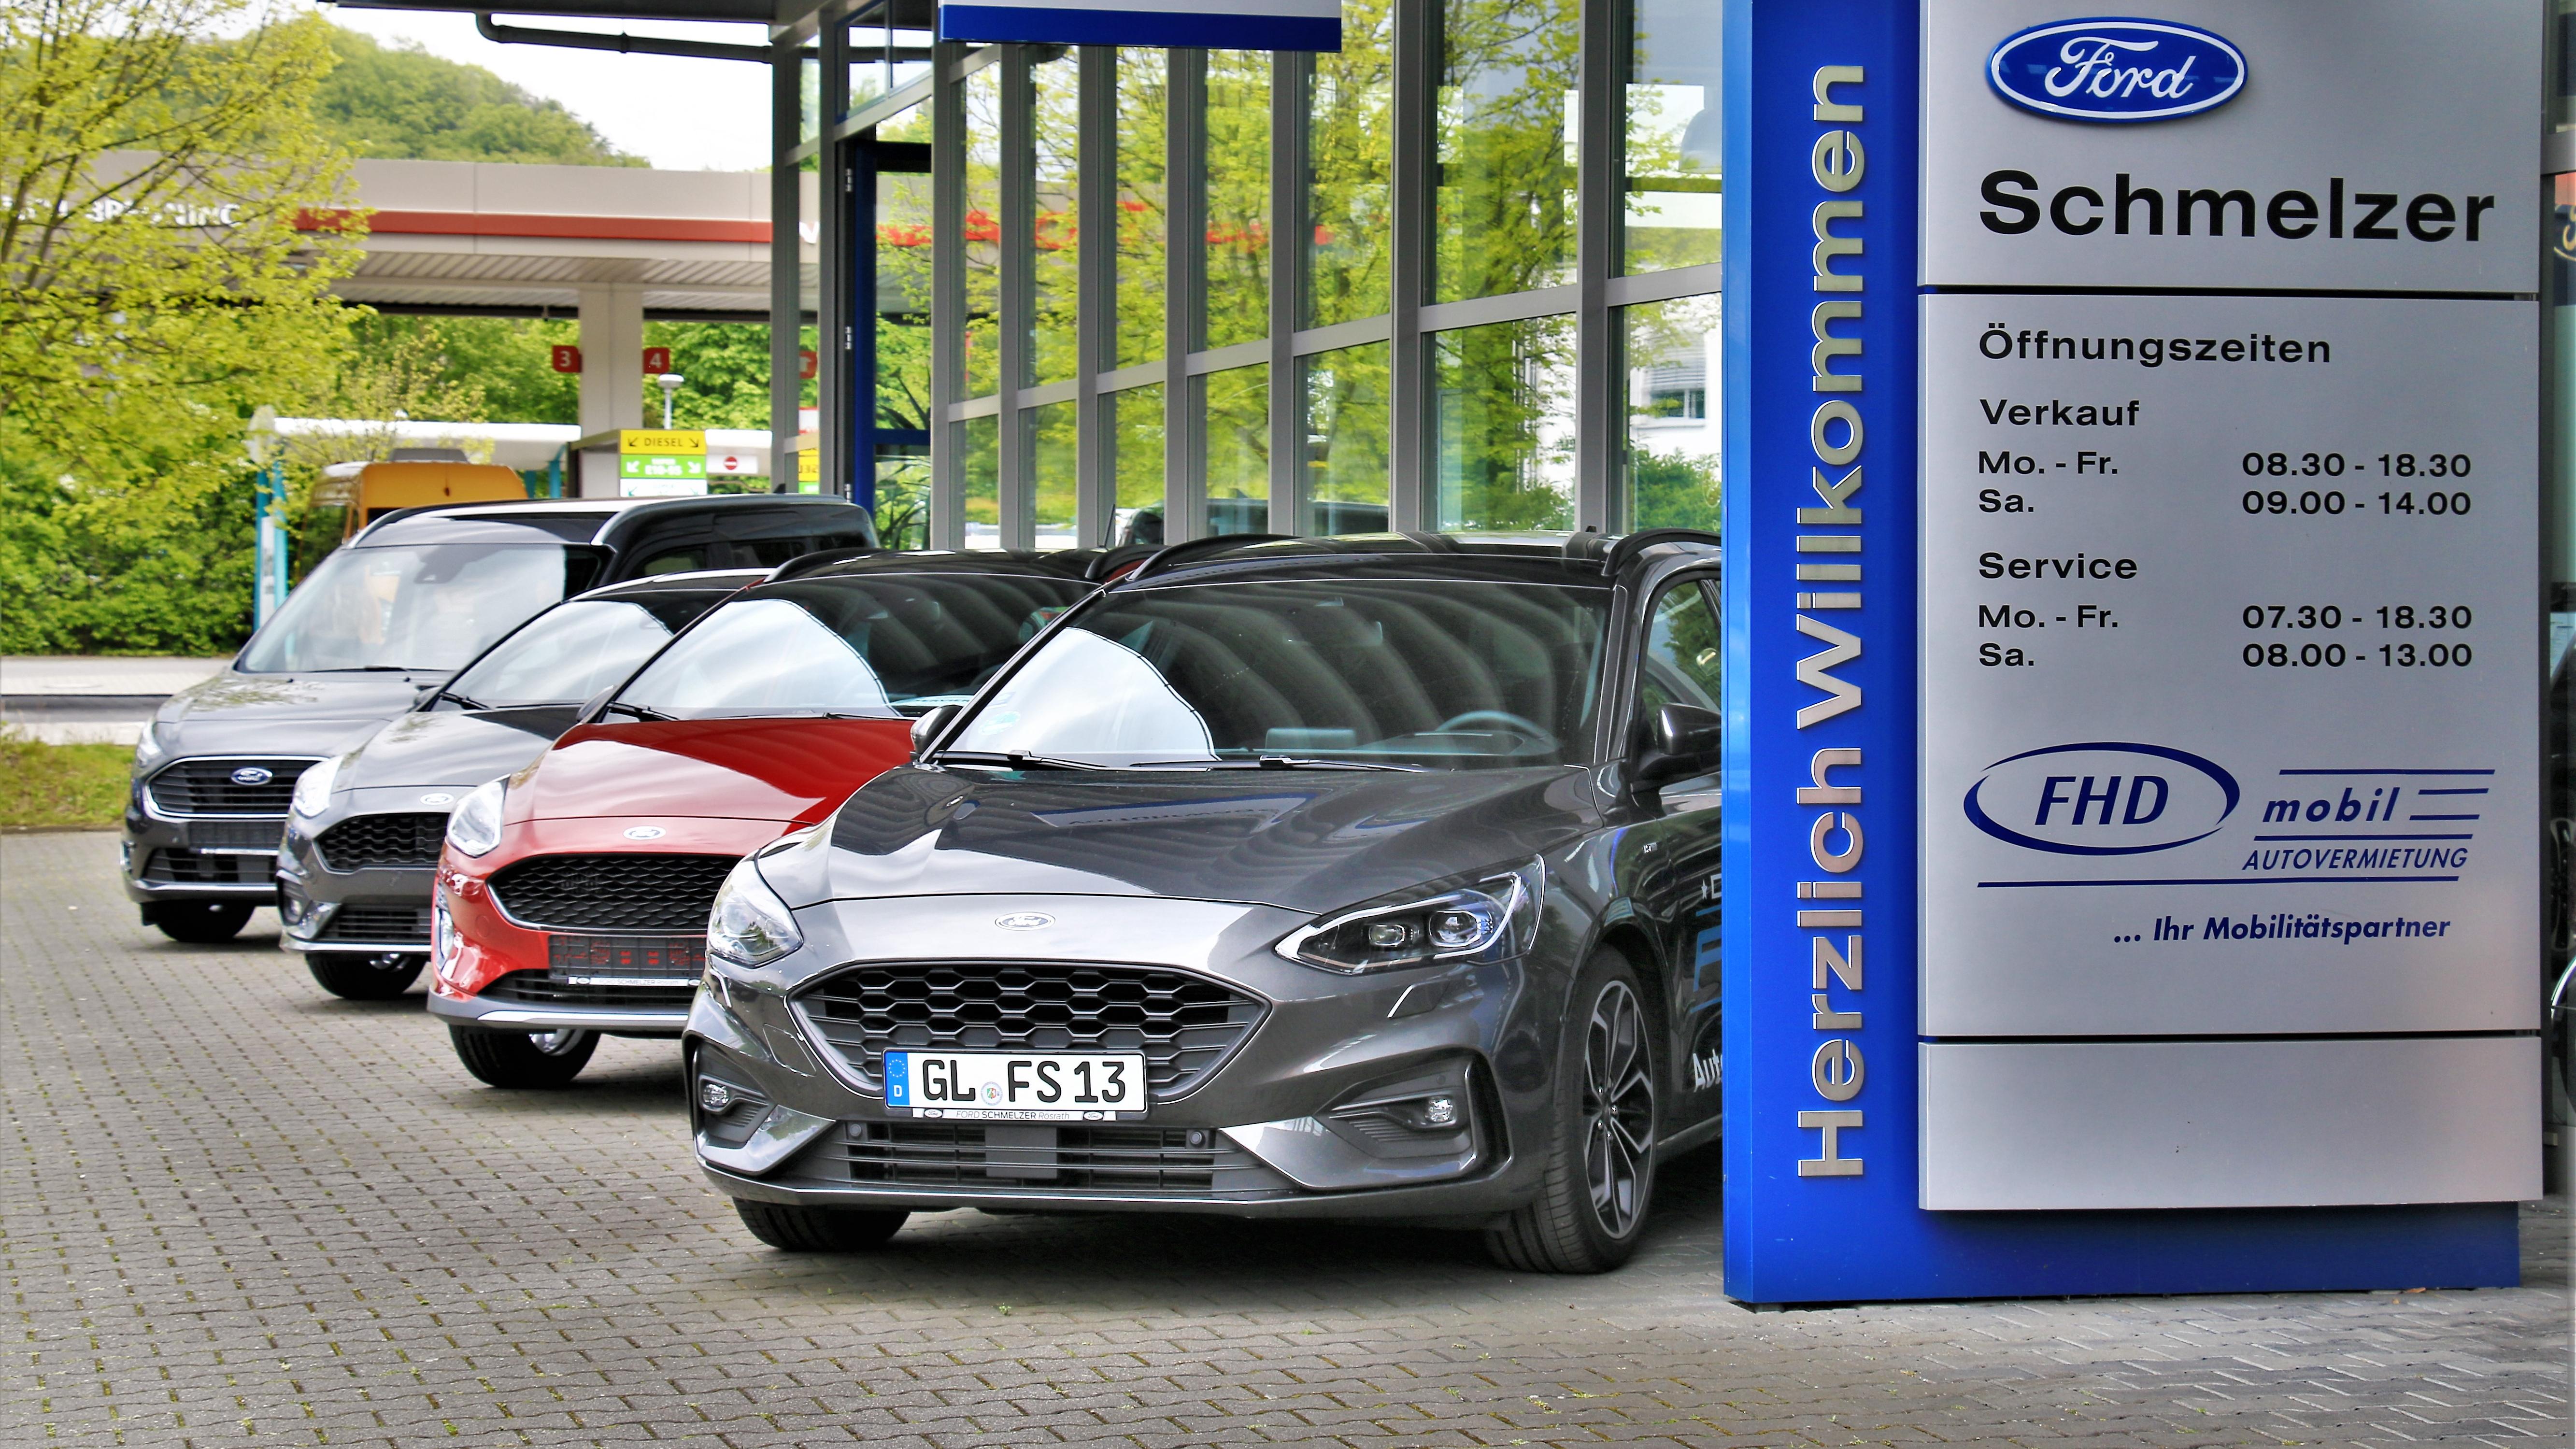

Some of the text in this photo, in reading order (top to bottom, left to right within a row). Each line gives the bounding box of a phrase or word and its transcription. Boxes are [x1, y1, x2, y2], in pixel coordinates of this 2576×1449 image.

[2045, 37, 2196, 98] Ford
[1980, 170, 2494, 242] Schmelzer
[560, 351, 571, 367] 3
[1979, 323, 2330, 368] Öffnungszeiten
[650, 353, 662, 369] 4
[1980, 399, 2139, 426] Verkauf
[644, 438, 683, 447] DIESEL
[1979, 451, 2045, 474] Mo.
[2078, 451, 2118, 474] Fr.
[2242, 453, 2345, 476] 08.30
[2378, 454, 2471, 478] 18.30
[1979, 489, 2034, 513] Sa.
[2242, 491, 2345, 514] 09.00
[2378, 492, 2471, 515] 14.00
[1979, 552, 2137, 579] Service
[1796, 64, 1865, 1177] Herzlich Willkommen
[1979, 605, 2045, 628] Mo.
[2078, 605, 2118, 628] Fr.
[2243, 605, 2341, 629] 07.30
[2377, 605, 2472, 629] 18.30
[1979, 643, 2034, 667] Sa.
[2243, 643, 2346, 667] 08.00
[2379, 643, 2472, 667] 13.00
[2035, 776, 2168, 825] FHD
[2263, 787, 2400, 823] mobil
[2242, 847, 2468, 870] AUTOVERMIETUNG
[2154, 916, 2194, 941] Ihr
[2203, 913, 2451, 945] Mobilitätspartner
[922, 1059, 1125, 1103] GL FS 13
[1693, 1049, 1722, 1093] Aut
[894, 1085, 902, 1097] D
[982, 1111, 1036, 1119] SCHMELZER
[1039, 1111, 1069, 1120] Rösrath
